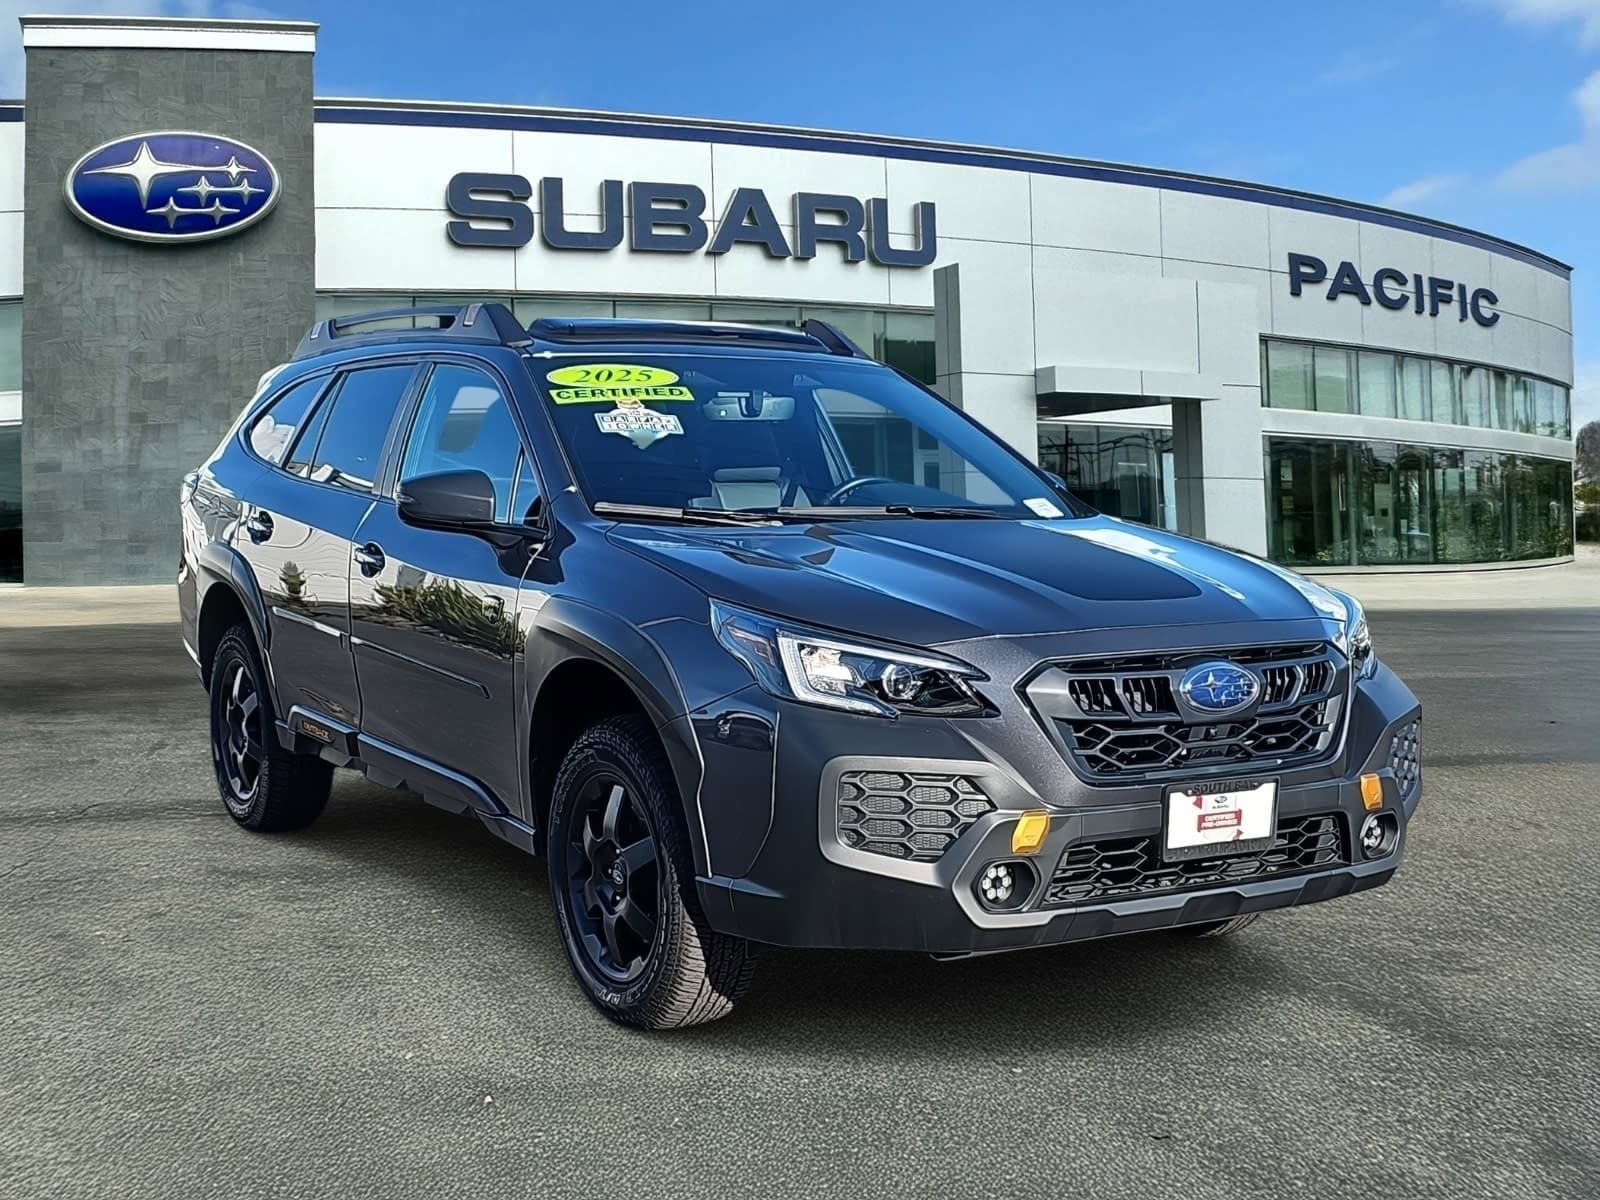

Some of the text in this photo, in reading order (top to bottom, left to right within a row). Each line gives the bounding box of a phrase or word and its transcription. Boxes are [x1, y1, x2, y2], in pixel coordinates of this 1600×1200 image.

[447, 172, 937, 266] SUBARU
[1287, 252, 1501, 327] PACIFIC
[556, 387, 684, 400] CERTIFIED
[574, 369, 654, 383] 2025
